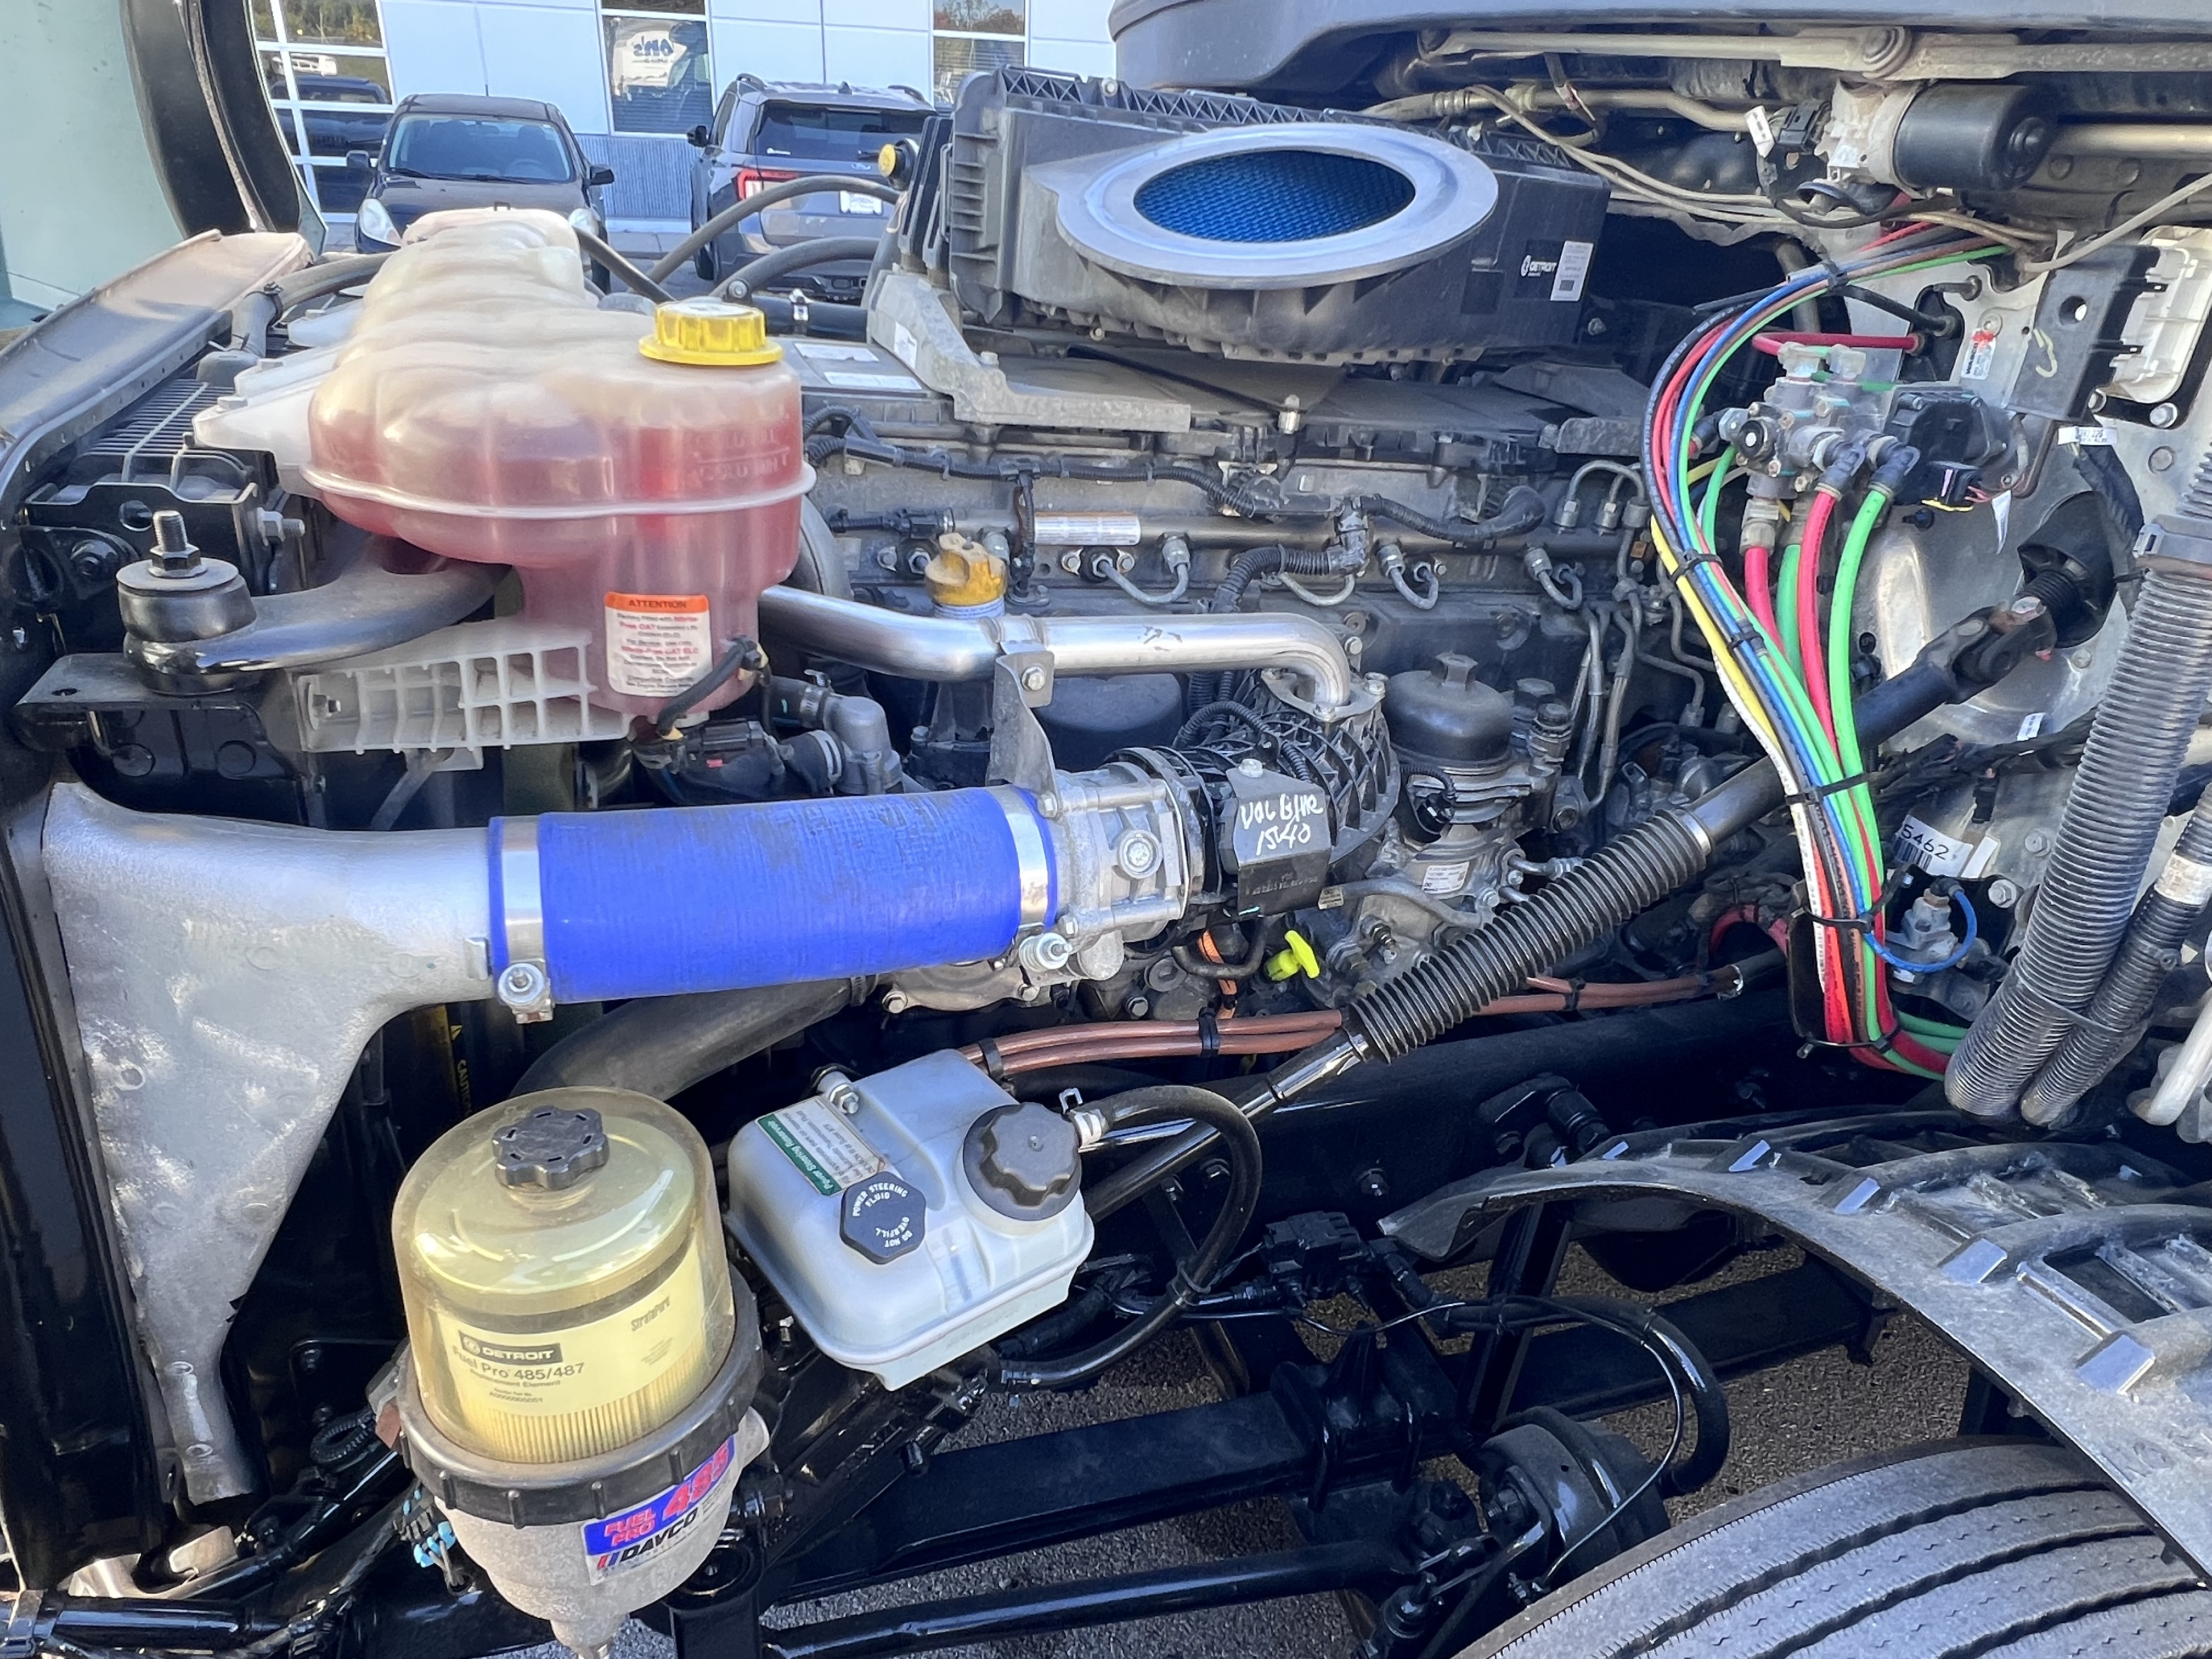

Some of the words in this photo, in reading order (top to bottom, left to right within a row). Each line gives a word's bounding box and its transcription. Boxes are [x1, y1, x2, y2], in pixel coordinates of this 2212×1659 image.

[629, 600, 687, 608] ATTENTION
[1901, 824, 1949, 860] 5462
[791, 1146, 816, 1171] Steering
[812, 1170, 834, 1190] Power
[853, 1191, 868, 1217] POWER
[868, 1182, 909, 1197] STEERING
[865, 1192, 890, 1207] FLUID
[876, 1217, 910, 1238] OVERFILL
[901, 1230, 913, 1242] DO
[884, 1237, 901, 1248] NOT
[482, 1346, 554, 1361] DETROIT
[481, 1362, 509, 1379] Pro
[514, 1362, 584, 1380] 485/487
[523, 1380, 560, 1388] Element
[604, 1506, 656, 1537] FUEL
[611, 1519, 656, 1547] PRO
[620, 1506, 699, 1562] DAVCO
